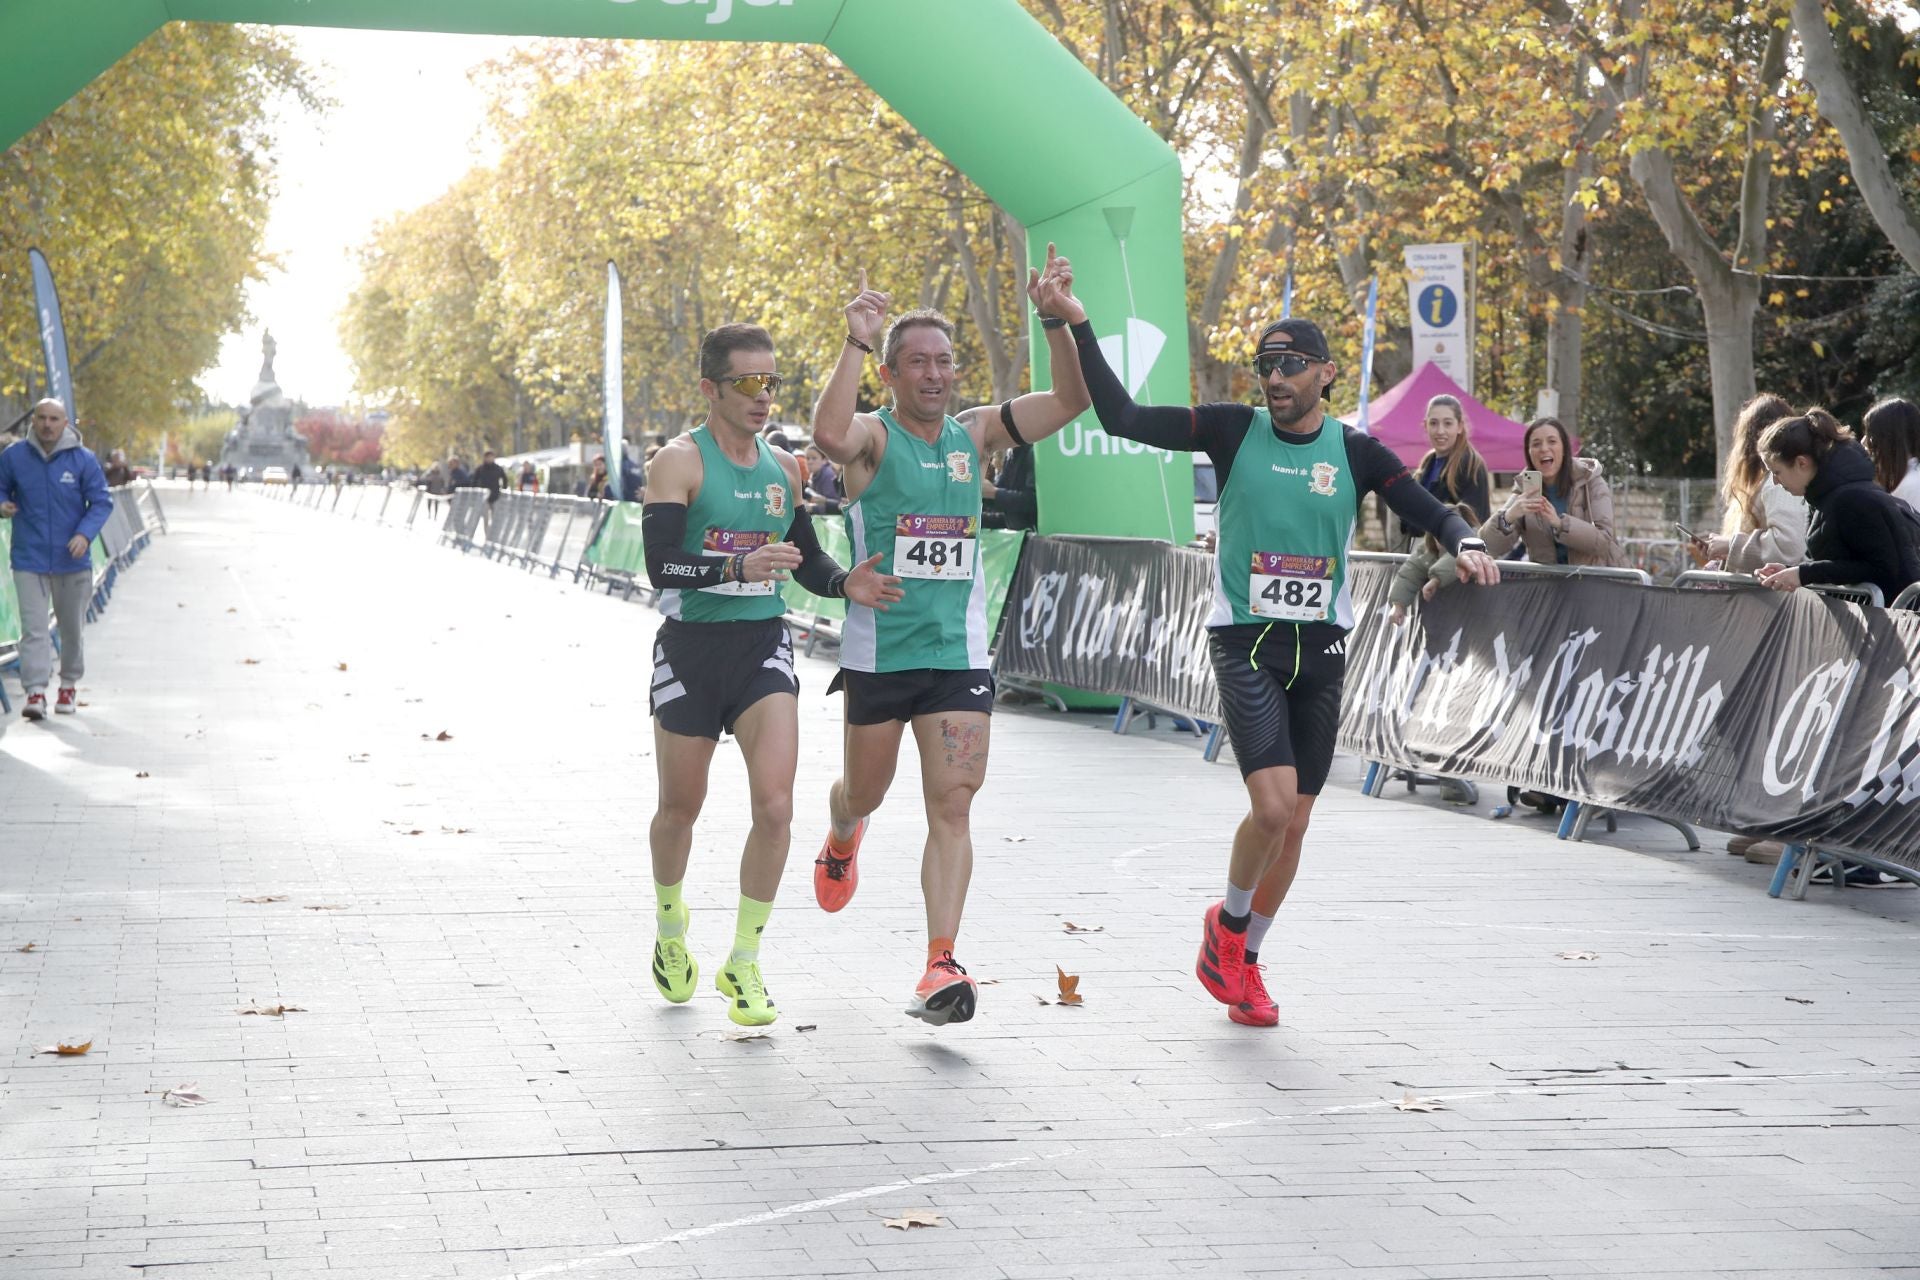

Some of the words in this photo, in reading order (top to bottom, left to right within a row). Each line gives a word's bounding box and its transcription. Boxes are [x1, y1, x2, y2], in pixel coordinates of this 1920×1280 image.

[906, 540, 963, 567] 481
[661, 563, 697, 577] TERREX
[1261, 578, 1322, 608] 482
